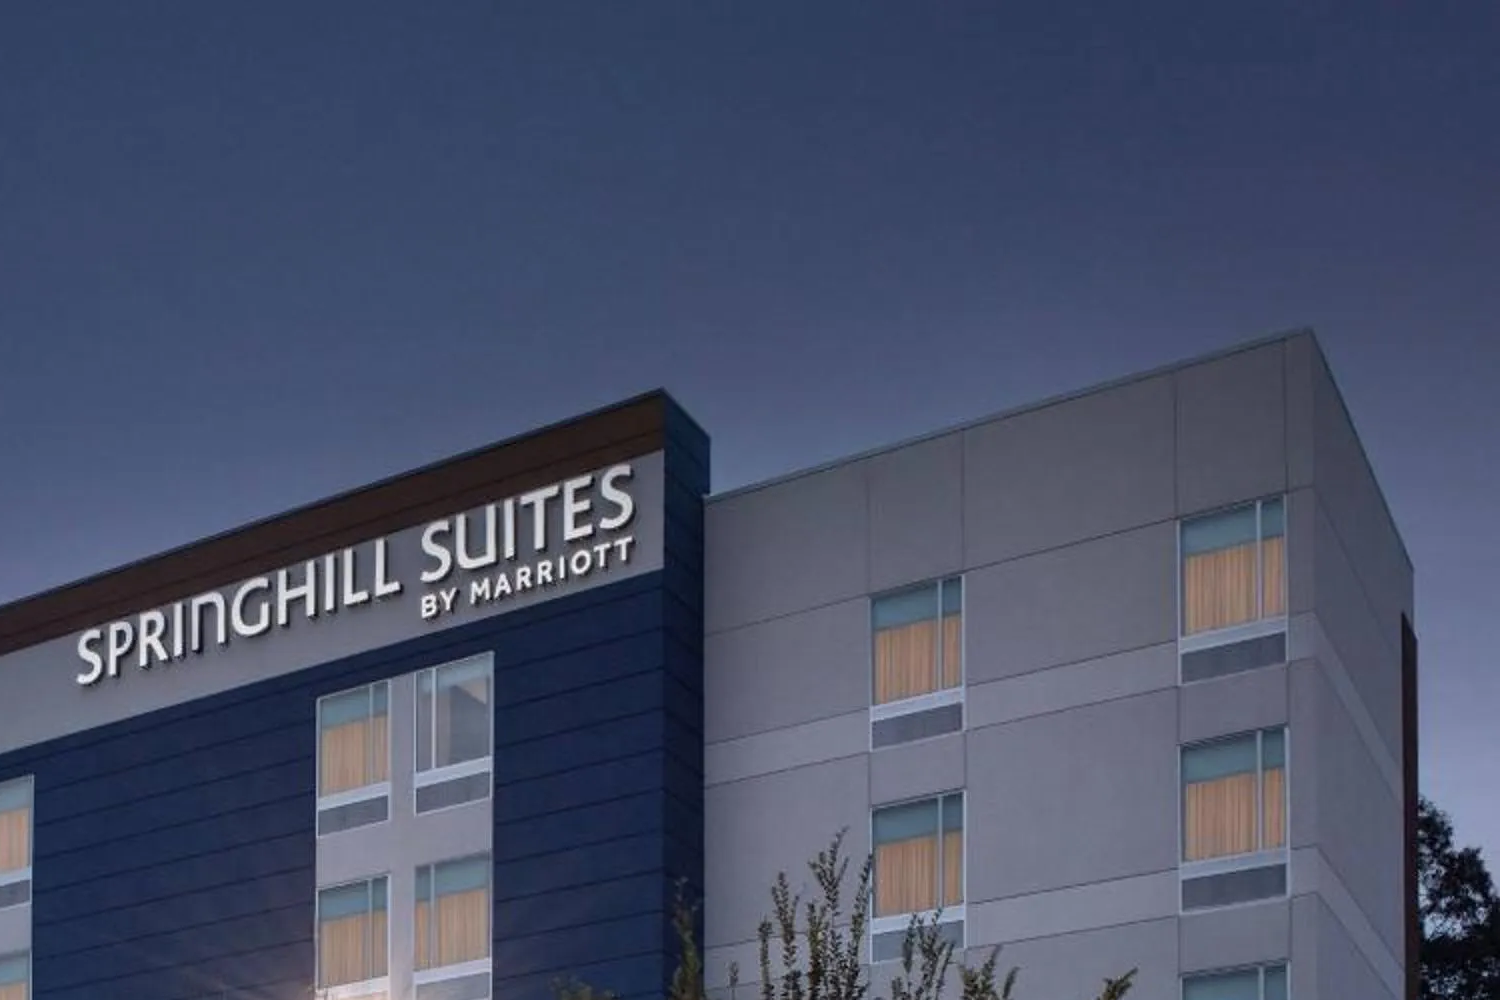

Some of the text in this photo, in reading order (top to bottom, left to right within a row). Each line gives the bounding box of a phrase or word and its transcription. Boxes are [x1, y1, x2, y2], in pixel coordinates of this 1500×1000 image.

[75, 464, 635, 685] SPRINGHILL SUITES
[421, 536, 634, 619] BY MARRIOTT
